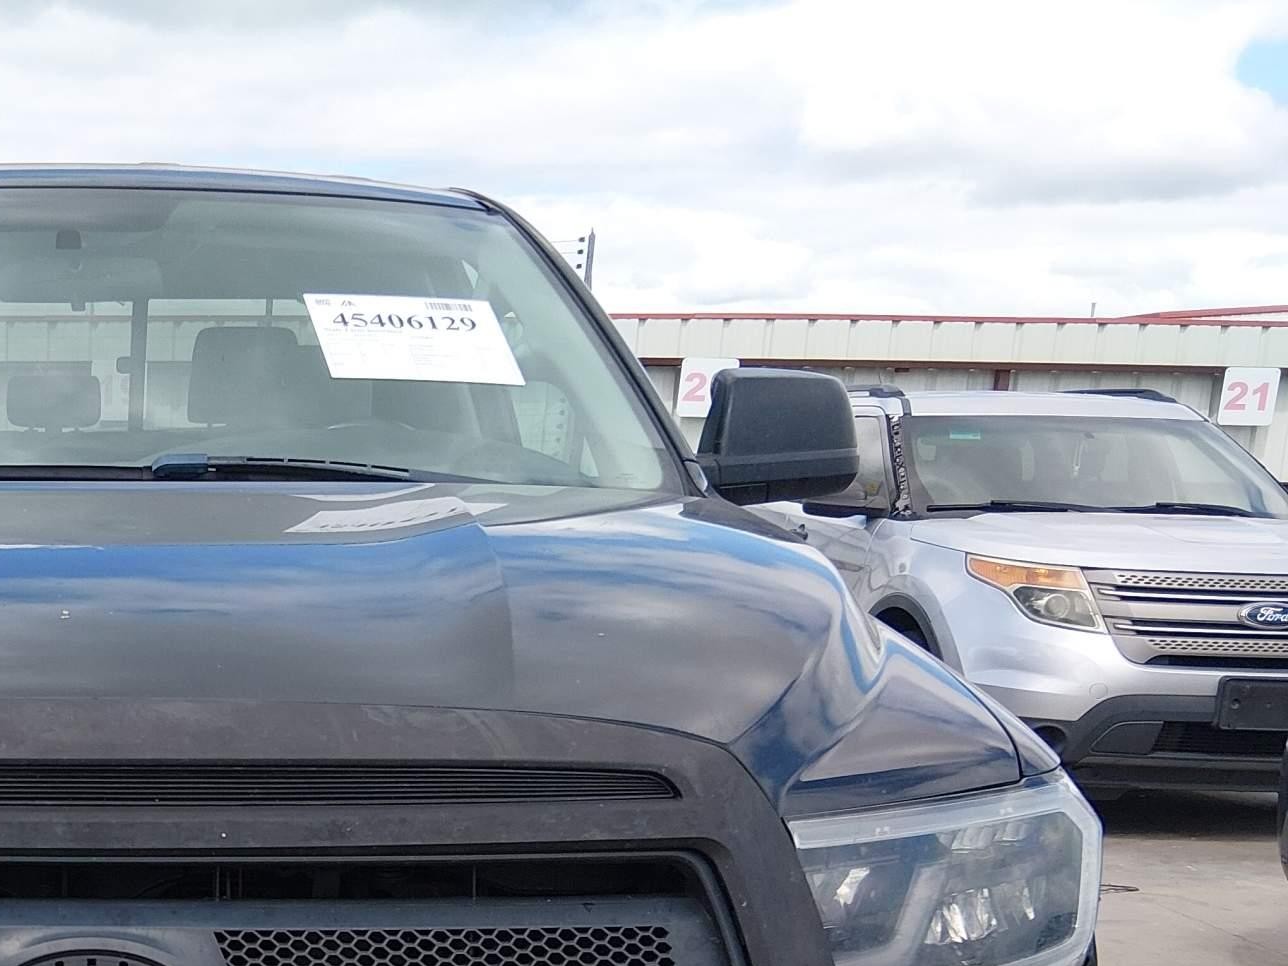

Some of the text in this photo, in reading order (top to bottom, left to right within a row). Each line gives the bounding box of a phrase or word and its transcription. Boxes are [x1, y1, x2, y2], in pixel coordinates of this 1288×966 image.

[332, 312, 477, 333] 45406129
[682, 371, 707, 402] 2
[1223, 381, 1270, 411] 21
